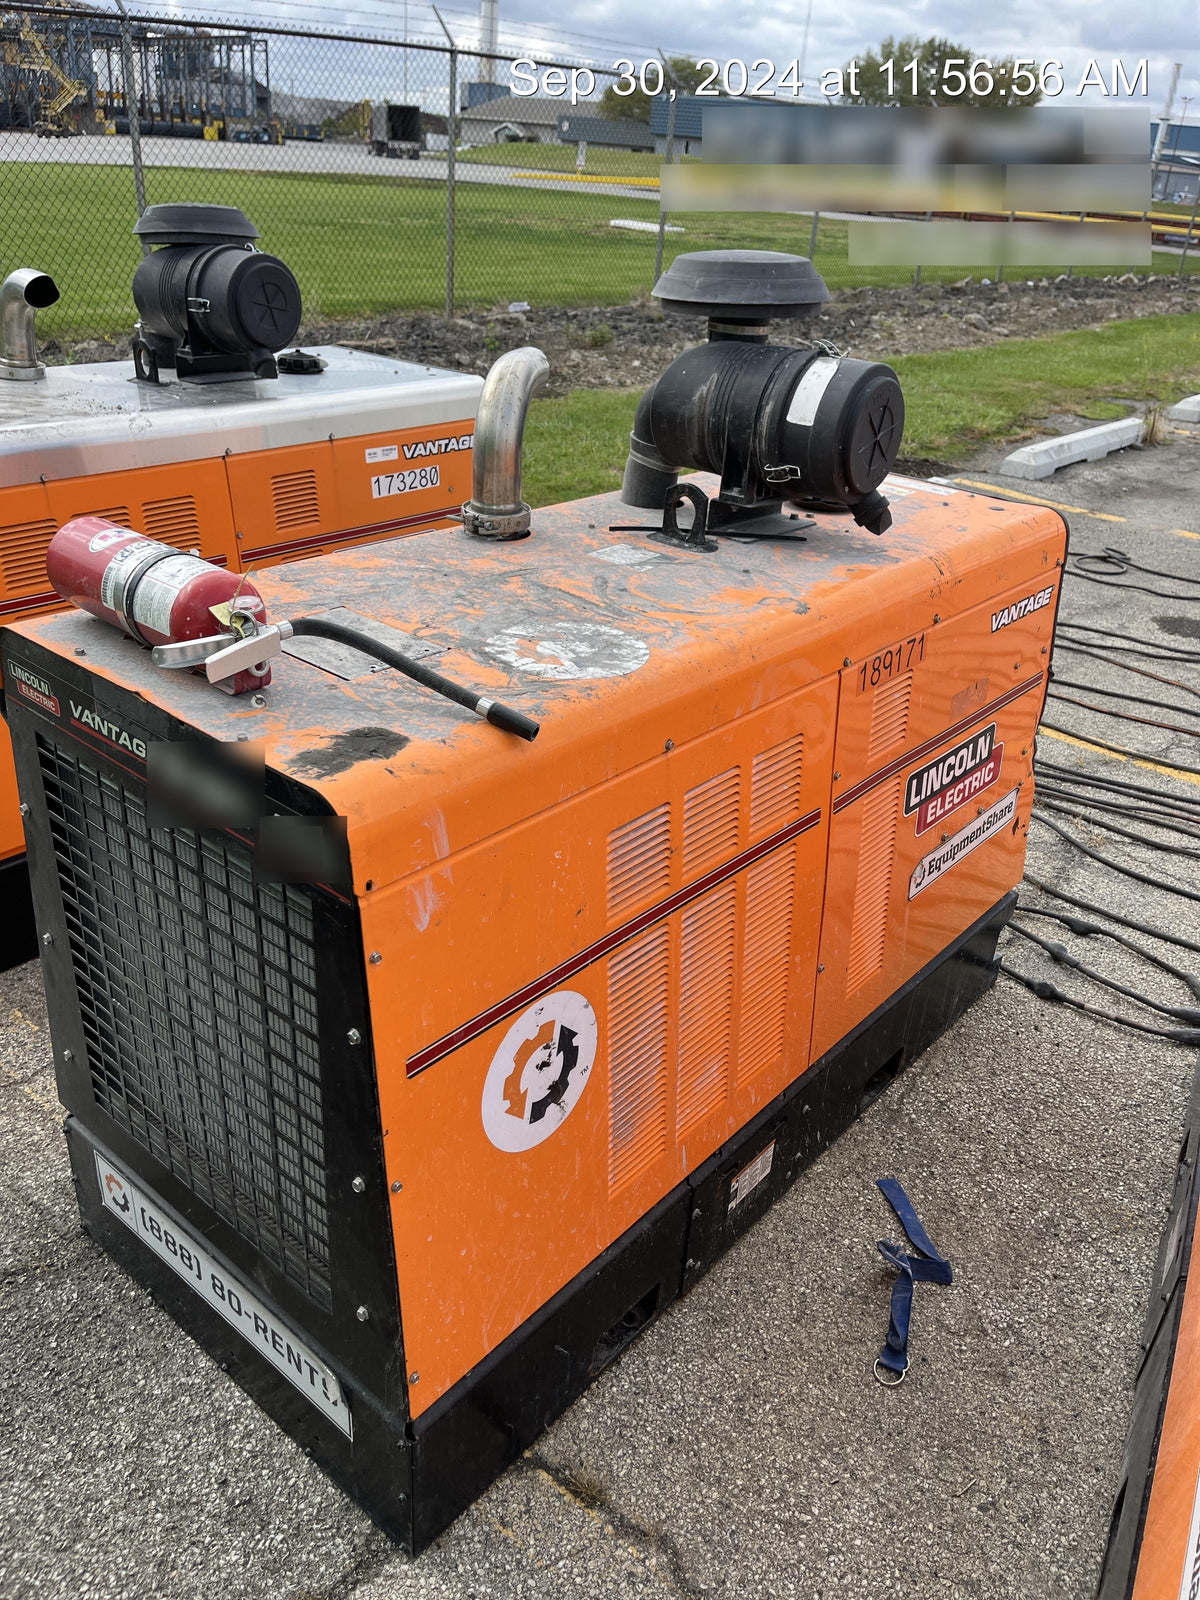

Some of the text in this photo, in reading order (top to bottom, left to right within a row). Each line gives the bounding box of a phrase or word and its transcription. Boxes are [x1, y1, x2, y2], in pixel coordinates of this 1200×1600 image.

[373, 466, 439, 497] 173280
[991, 585, 1054, 634] VANTAGE
[10, 663, 49, 696] LINCOLN
[859, 633, 926, 692] 189171
[21, 684, 56, 711] ELECTRIC
[69, 699, 147, 758] VANTAG
[909, 732, 992, 807] LINCOLN
[926, 762, 995, 824] ELECTRIC
[927, 799, 1015, 876] EquipmentShare
[139, 1206, 203, 1281] (888)
